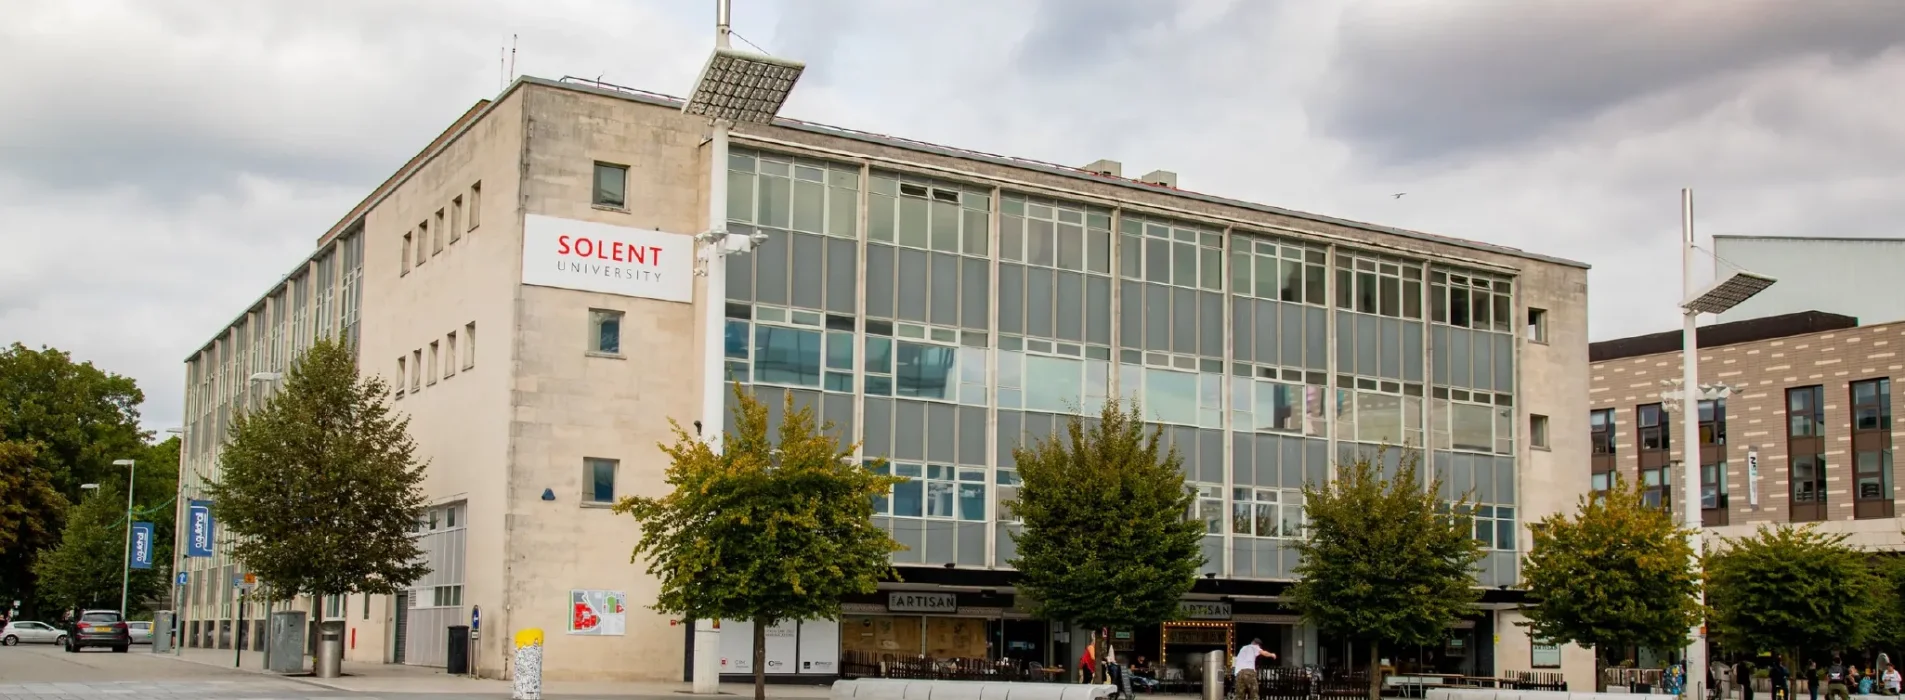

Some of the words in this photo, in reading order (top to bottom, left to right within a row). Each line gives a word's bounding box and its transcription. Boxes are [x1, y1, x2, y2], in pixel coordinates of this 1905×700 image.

[557, 235, 663, 266] SOLENT
[557, 260, 662, 282] UNIVERSITY
[896, 596, 954, 608] ARTISAN
